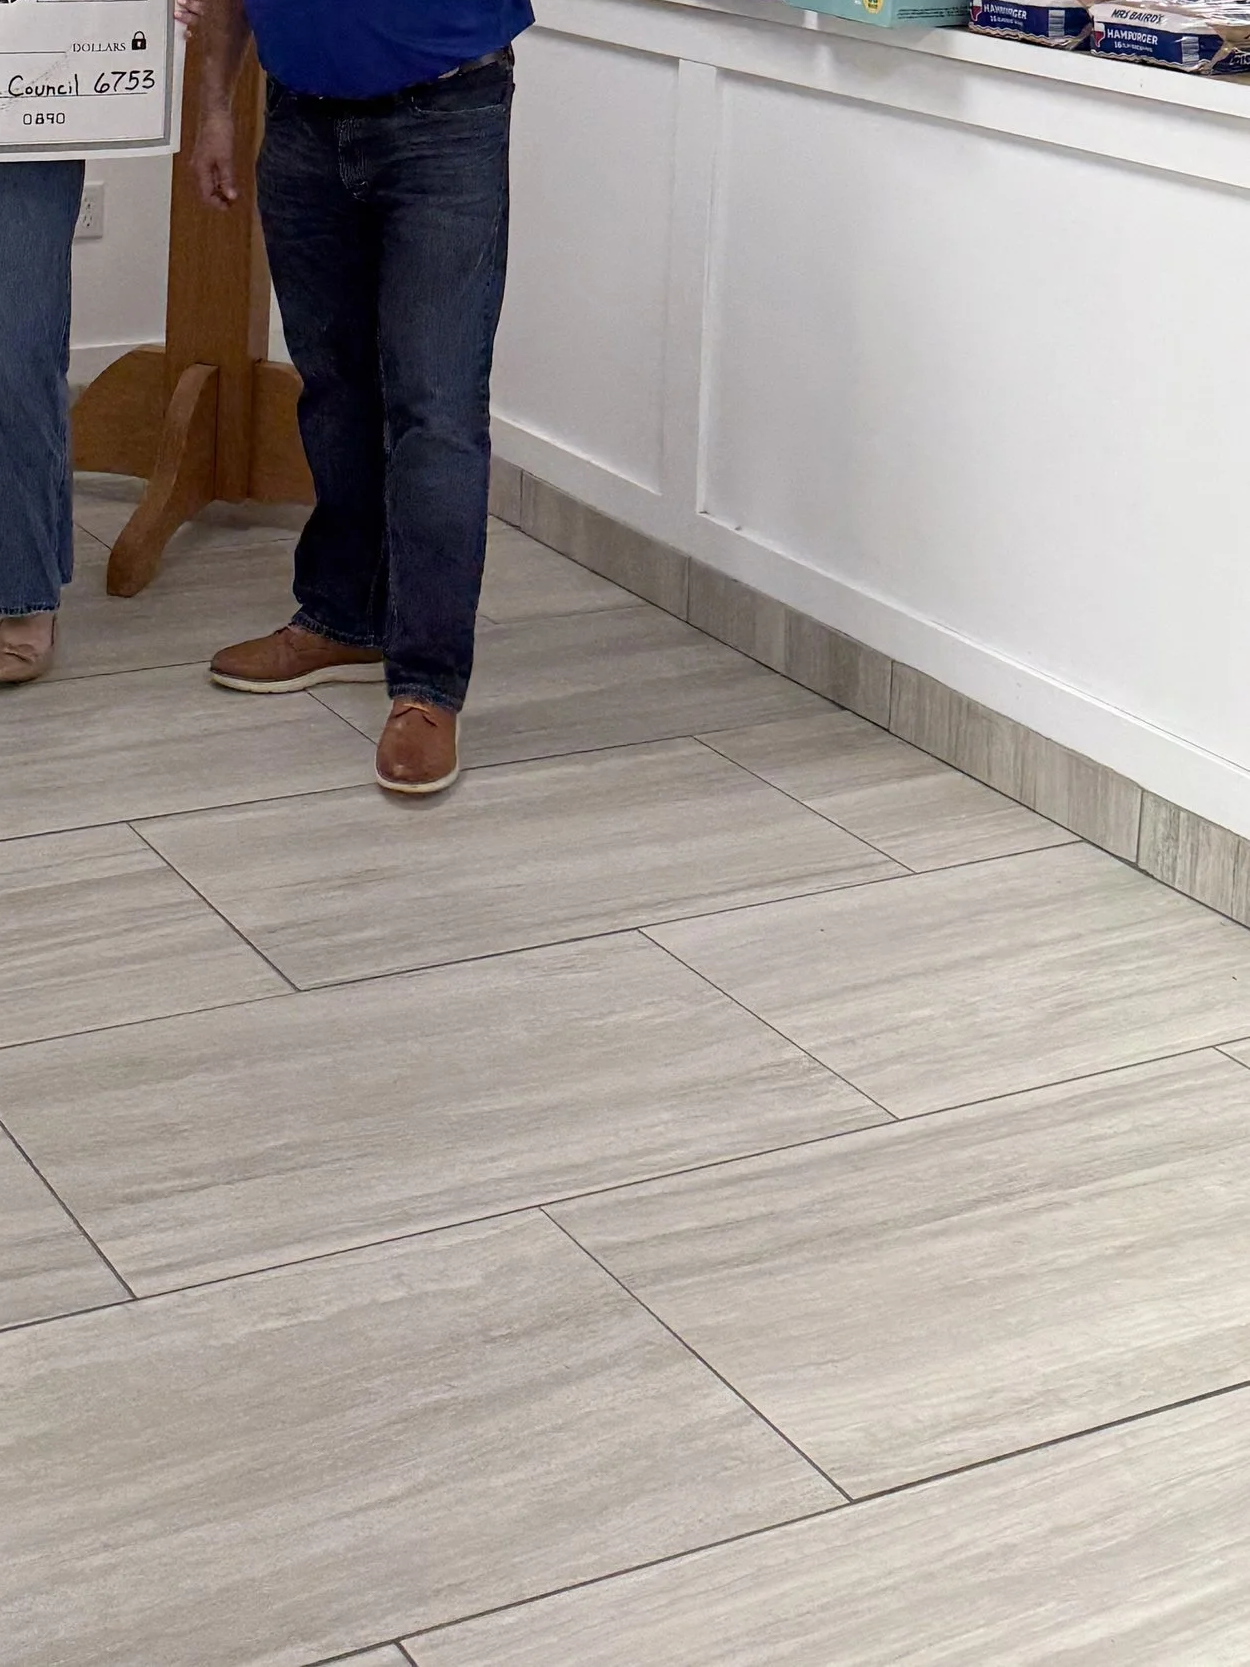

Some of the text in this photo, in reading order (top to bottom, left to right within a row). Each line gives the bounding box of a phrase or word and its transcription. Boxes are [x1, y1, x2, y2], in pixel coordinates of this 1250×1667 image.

[1106, 28, 1159, 45] HAMBURGER
[72, 42, 127, 54] DOLLARS
[7, 73, 80, 97] Council
[93, 69, 156, 95] 6753
